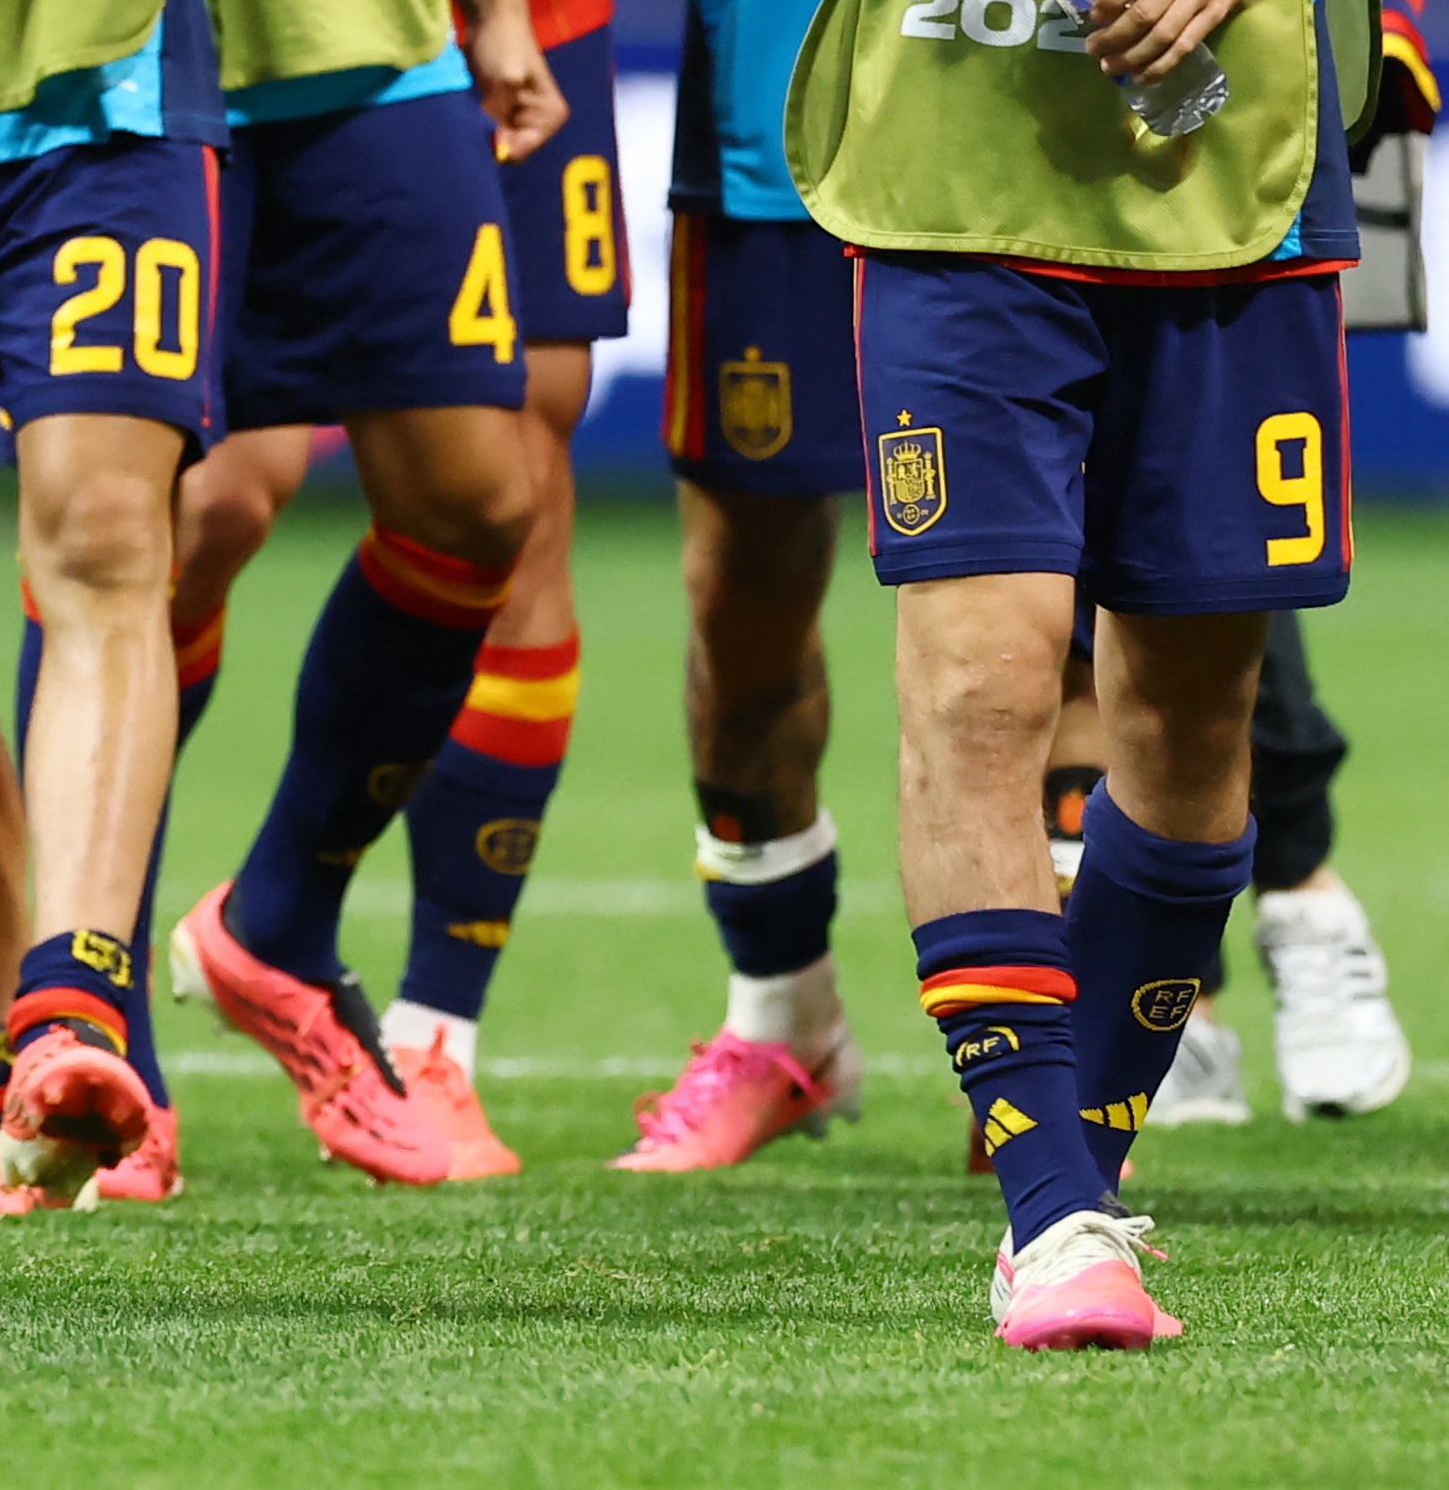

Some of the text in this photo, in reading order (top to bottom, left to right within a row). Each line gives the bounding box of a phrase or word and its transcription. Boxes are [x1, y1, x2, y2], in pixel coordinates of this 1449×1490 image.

[449, 223, 516, 364] 4
[561, 153, 617, 296] 8
[50, 236, 200, 380] 20
[1255, 411, 1325, 567] 9
[965, 1035, 1001, 1060] RF
[1148, 1003, 1189, 1020] EF
[1154, 988, 1193, 1003] RF
